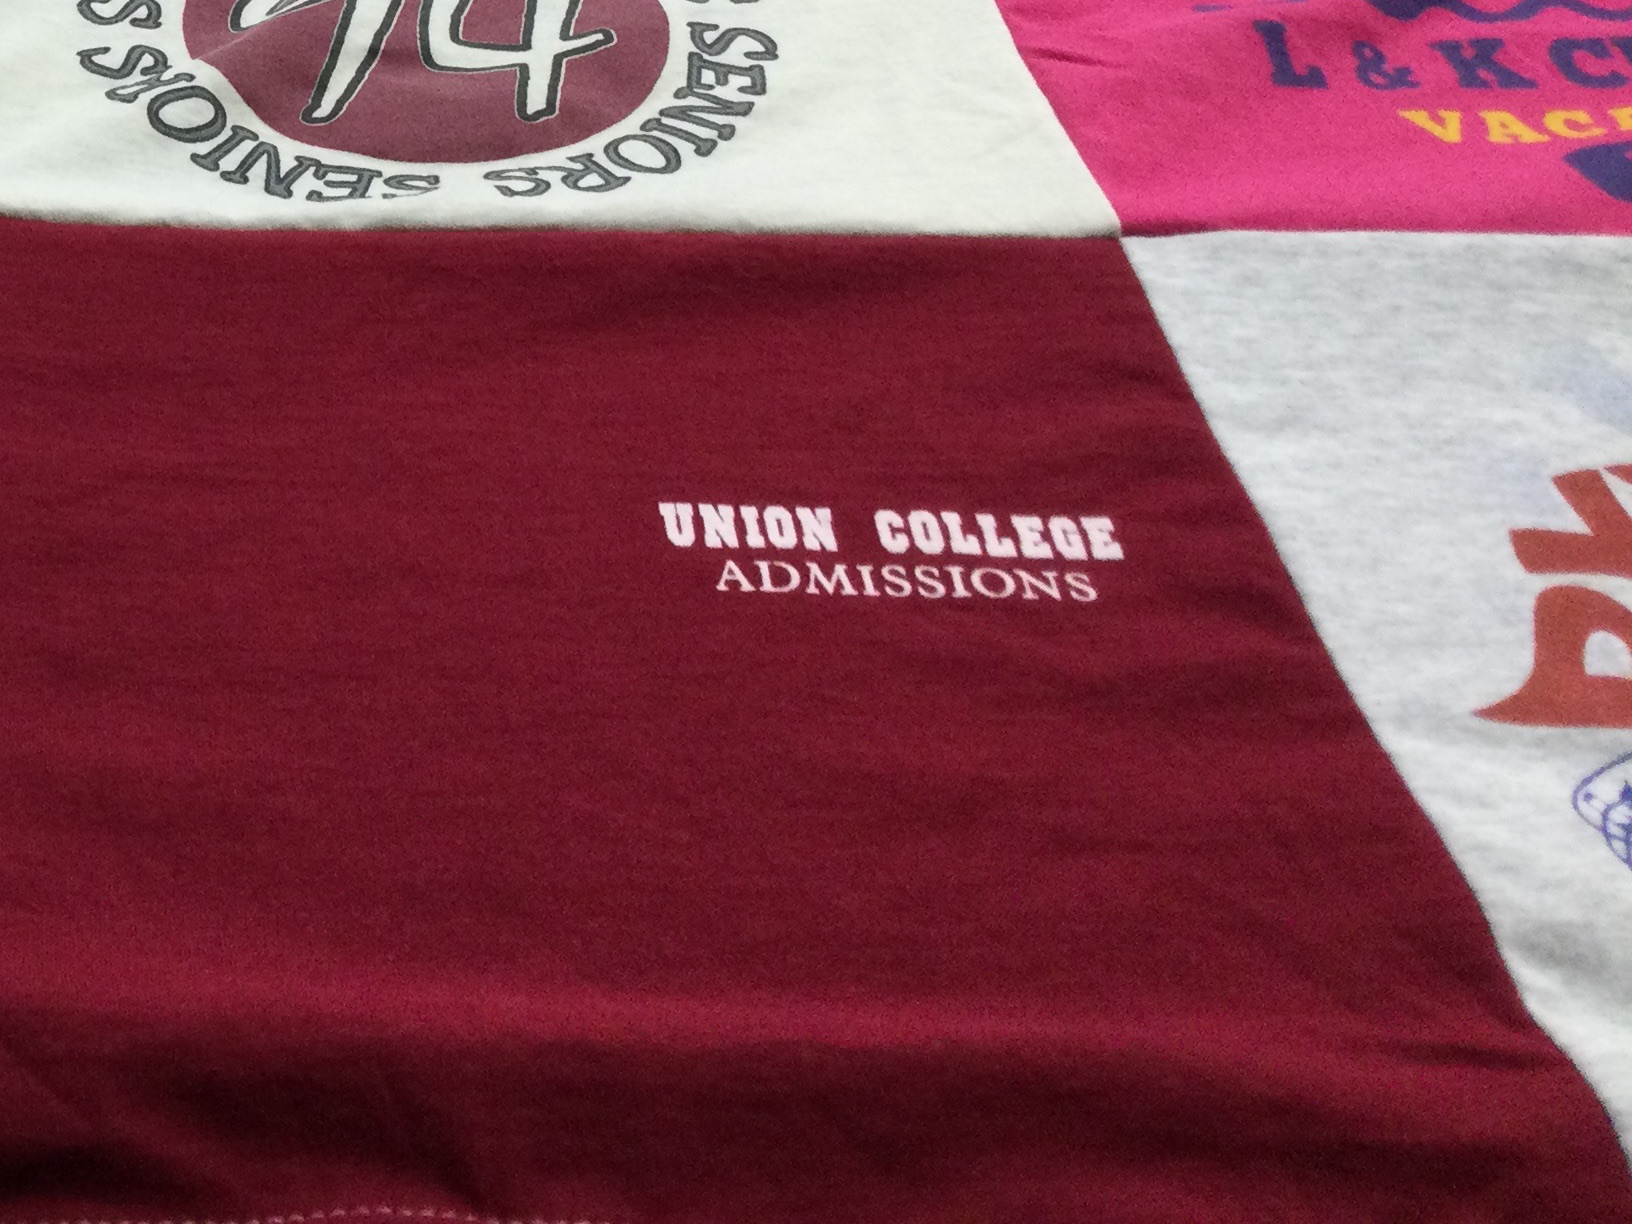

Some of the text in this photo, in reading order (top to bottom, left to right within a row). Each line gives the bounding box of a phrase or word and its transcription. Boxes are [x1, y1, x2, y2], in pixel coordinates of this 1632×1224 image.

[1252, 19, 1328, 90] L
[76, 21, 779, 203] SENIORS SENIORS
[658, 502, 1125, 561] UNION COLLEGE
[715, 559, 1098, 603] ADMISSIONS
